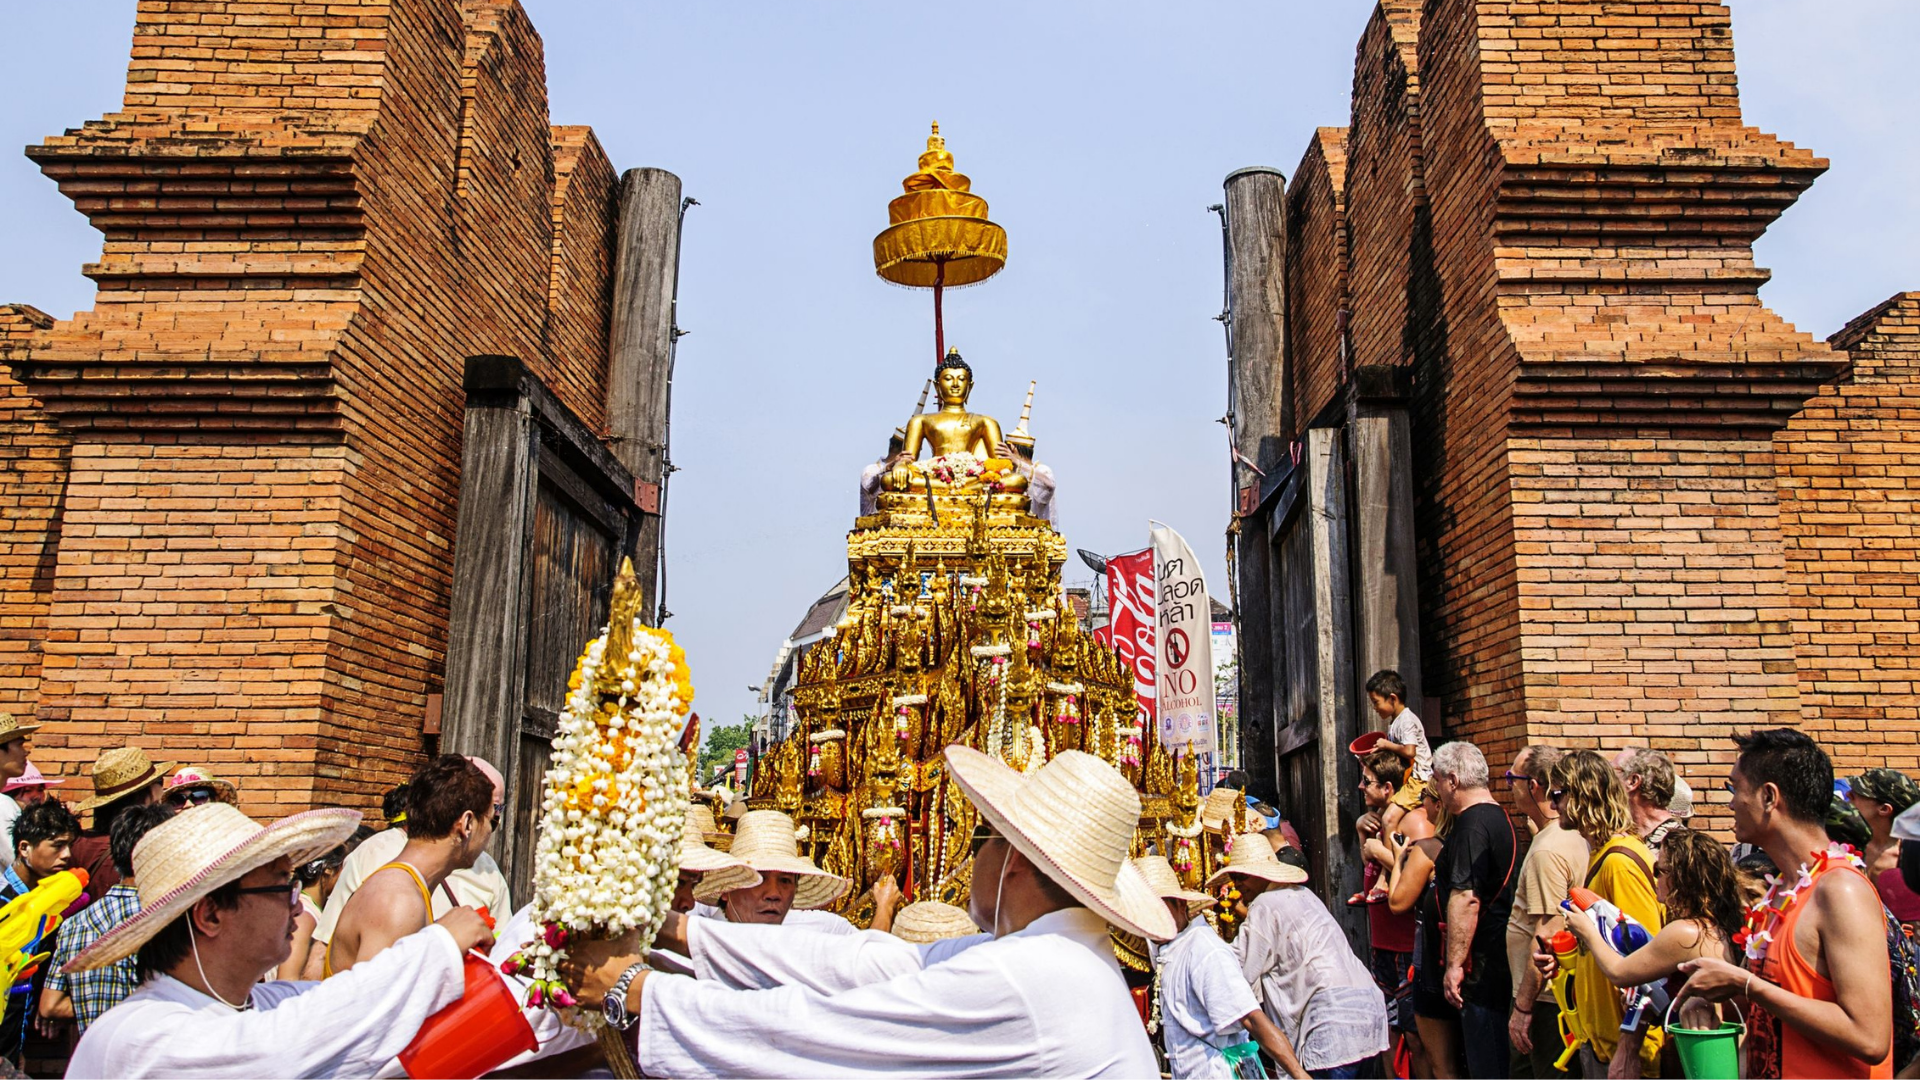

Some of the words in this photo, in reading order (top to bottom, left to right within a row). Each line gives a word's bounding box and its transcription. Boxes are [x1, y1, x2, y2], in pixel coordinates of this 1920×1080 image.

[1159, 601, 1194, 628] หล้า
[1164, 668, 1197, 698] NO
[1161, 696, 1203, 712] ALCOHOL
